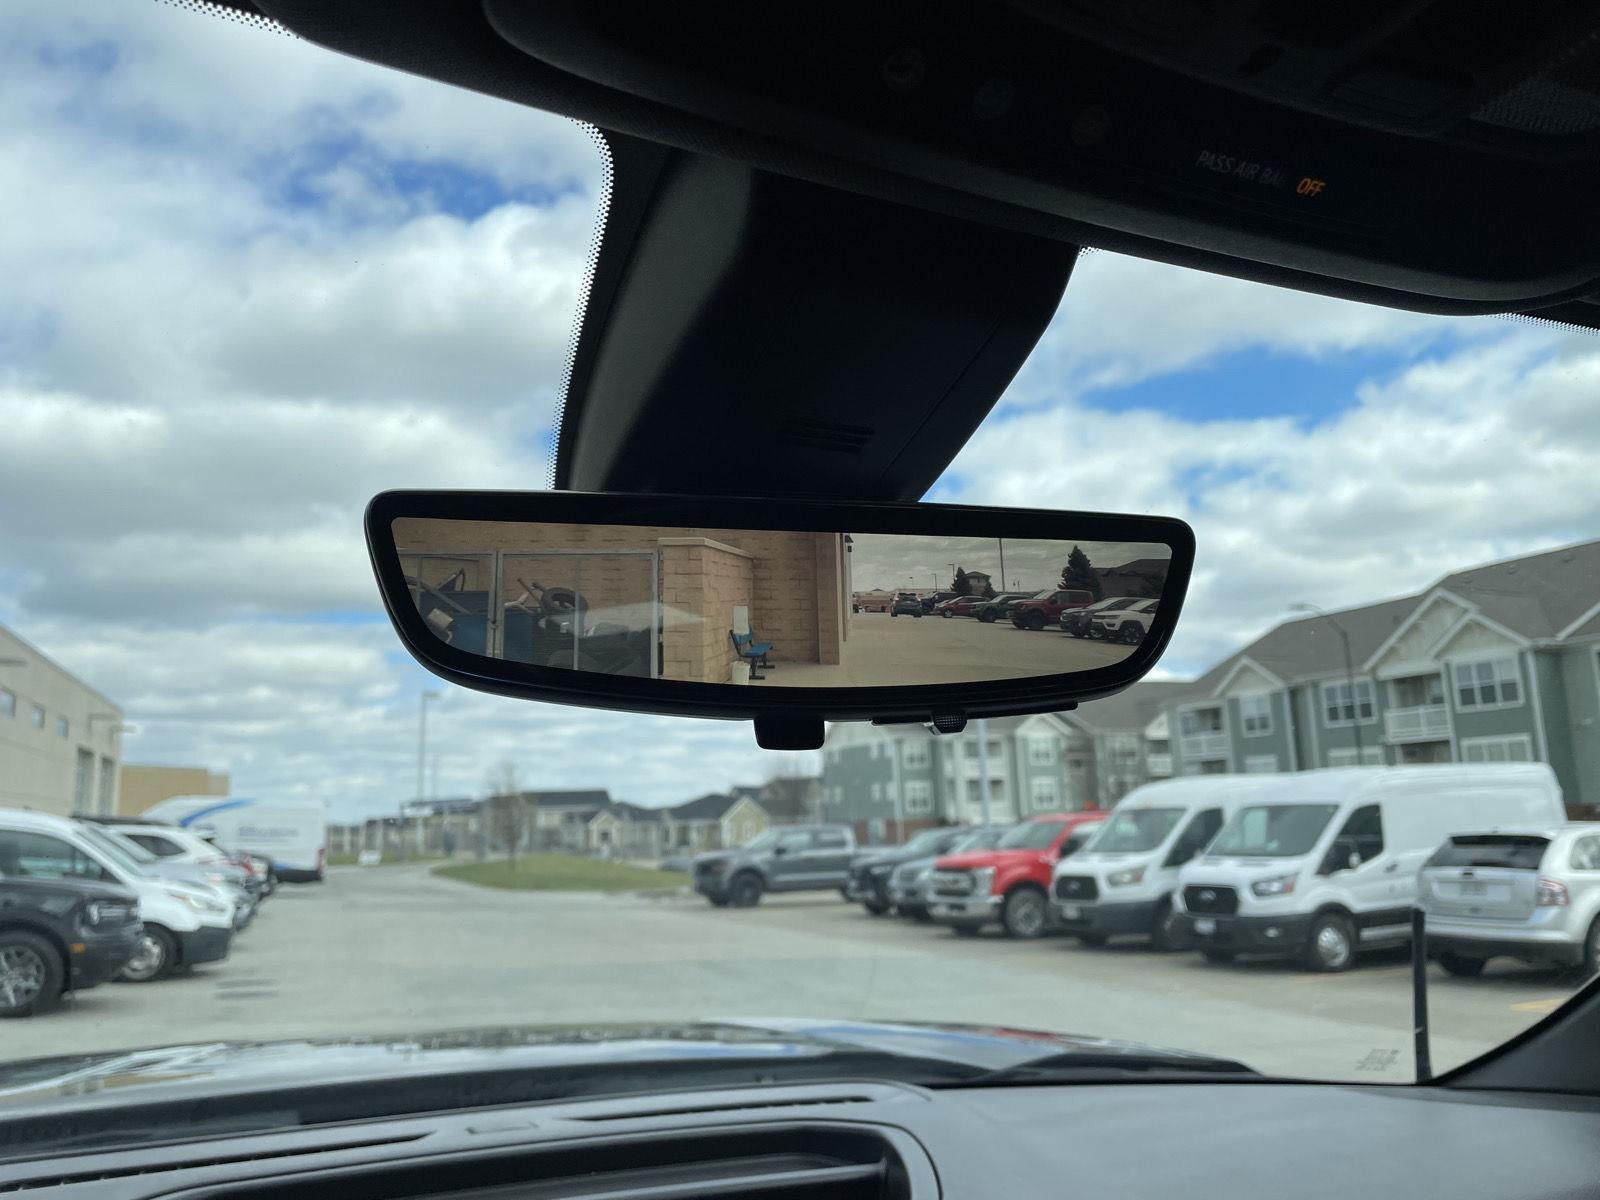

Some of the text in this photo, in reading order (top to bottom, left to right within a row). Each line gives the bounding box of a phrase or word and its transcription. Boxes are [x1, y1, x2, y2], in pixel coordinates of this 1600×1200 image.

[1195, 150, 1236, 173] PASS
[1234, 162, 1260, 181] AIR
[1296, 177, 1326, 196] OFF
